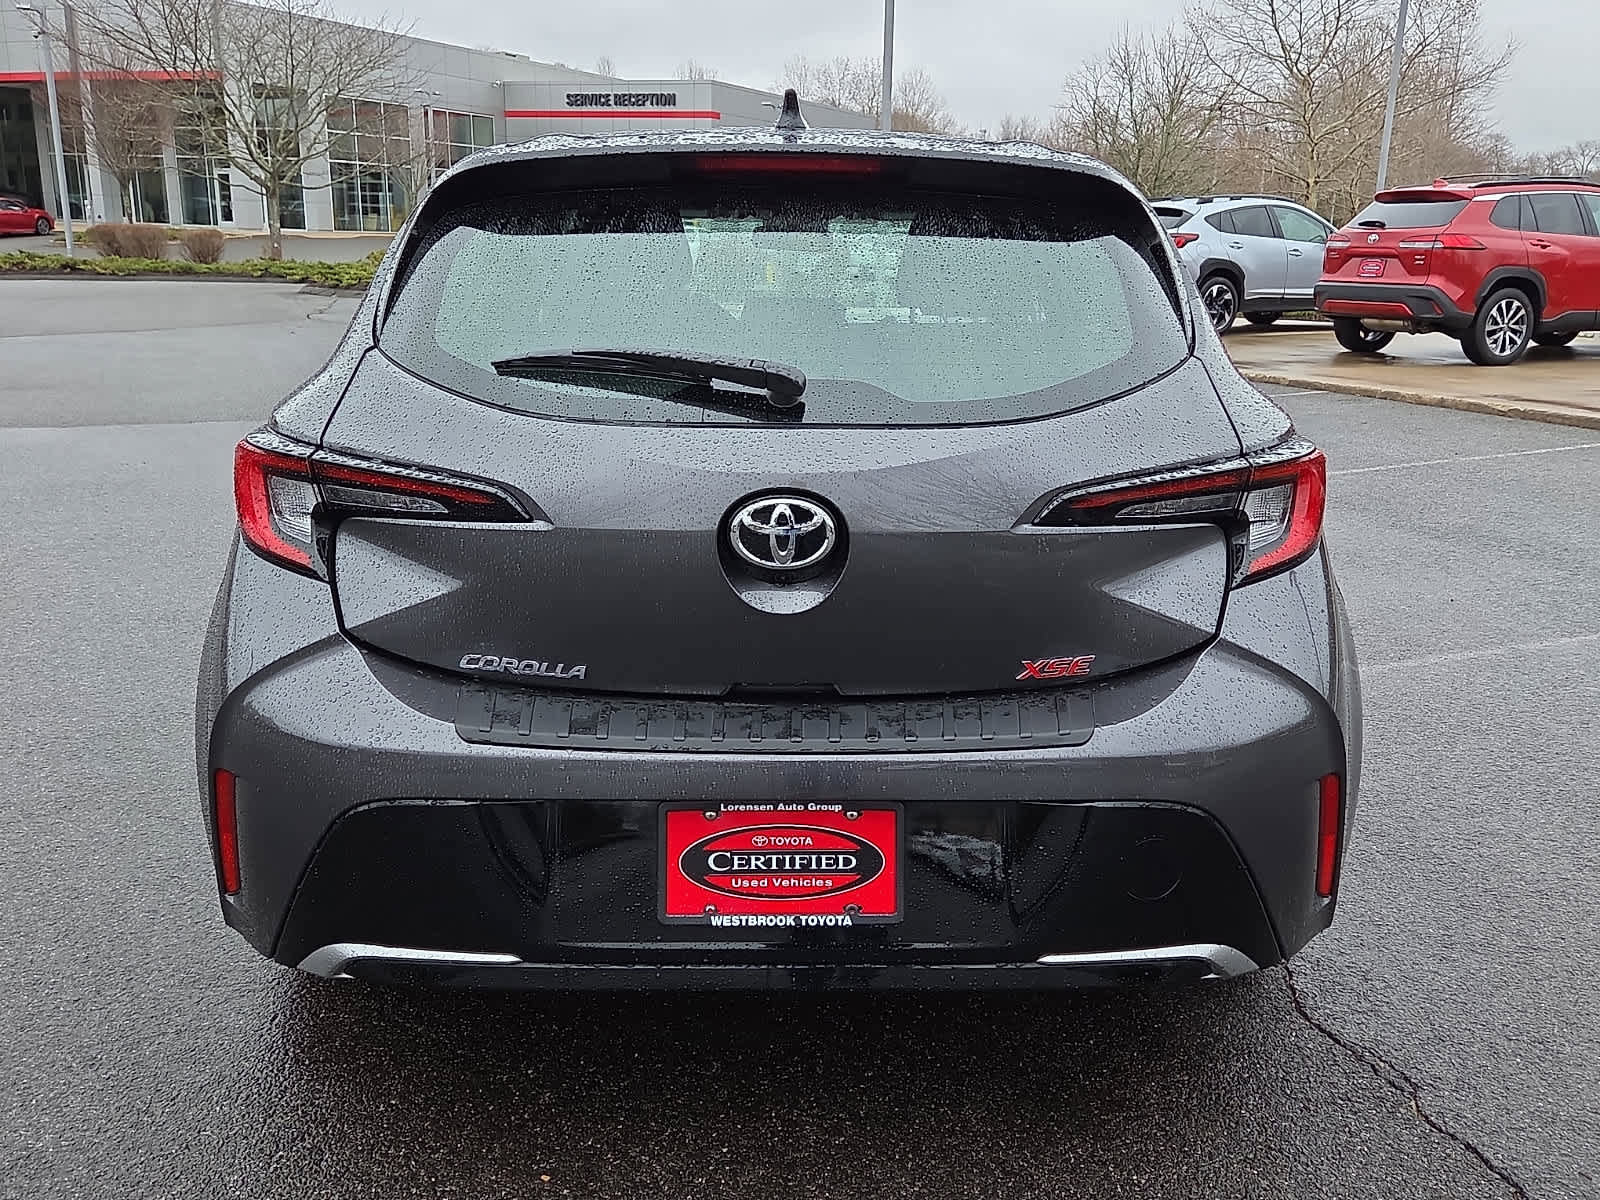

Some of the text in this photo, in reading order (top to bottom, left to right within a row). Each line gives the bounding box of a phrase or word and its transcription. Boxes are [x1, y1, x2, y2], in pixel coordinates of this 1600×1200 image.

[566, 93, 677, 107] SERVICE RECEPTION
[459, 653, 587, 680] COROLLA
[1015, 655, 1096, 680] XSE
[720, 803, 842, 812] Lorensen Auto Group
[769, 836, 813, 846] TOYOTA
[707, 851, 857, 872] CERTIFIED
[731, 877, 833, 888] Used Vehicles
[710, 915, 853, 926] WESTBROOK TOYOTA
